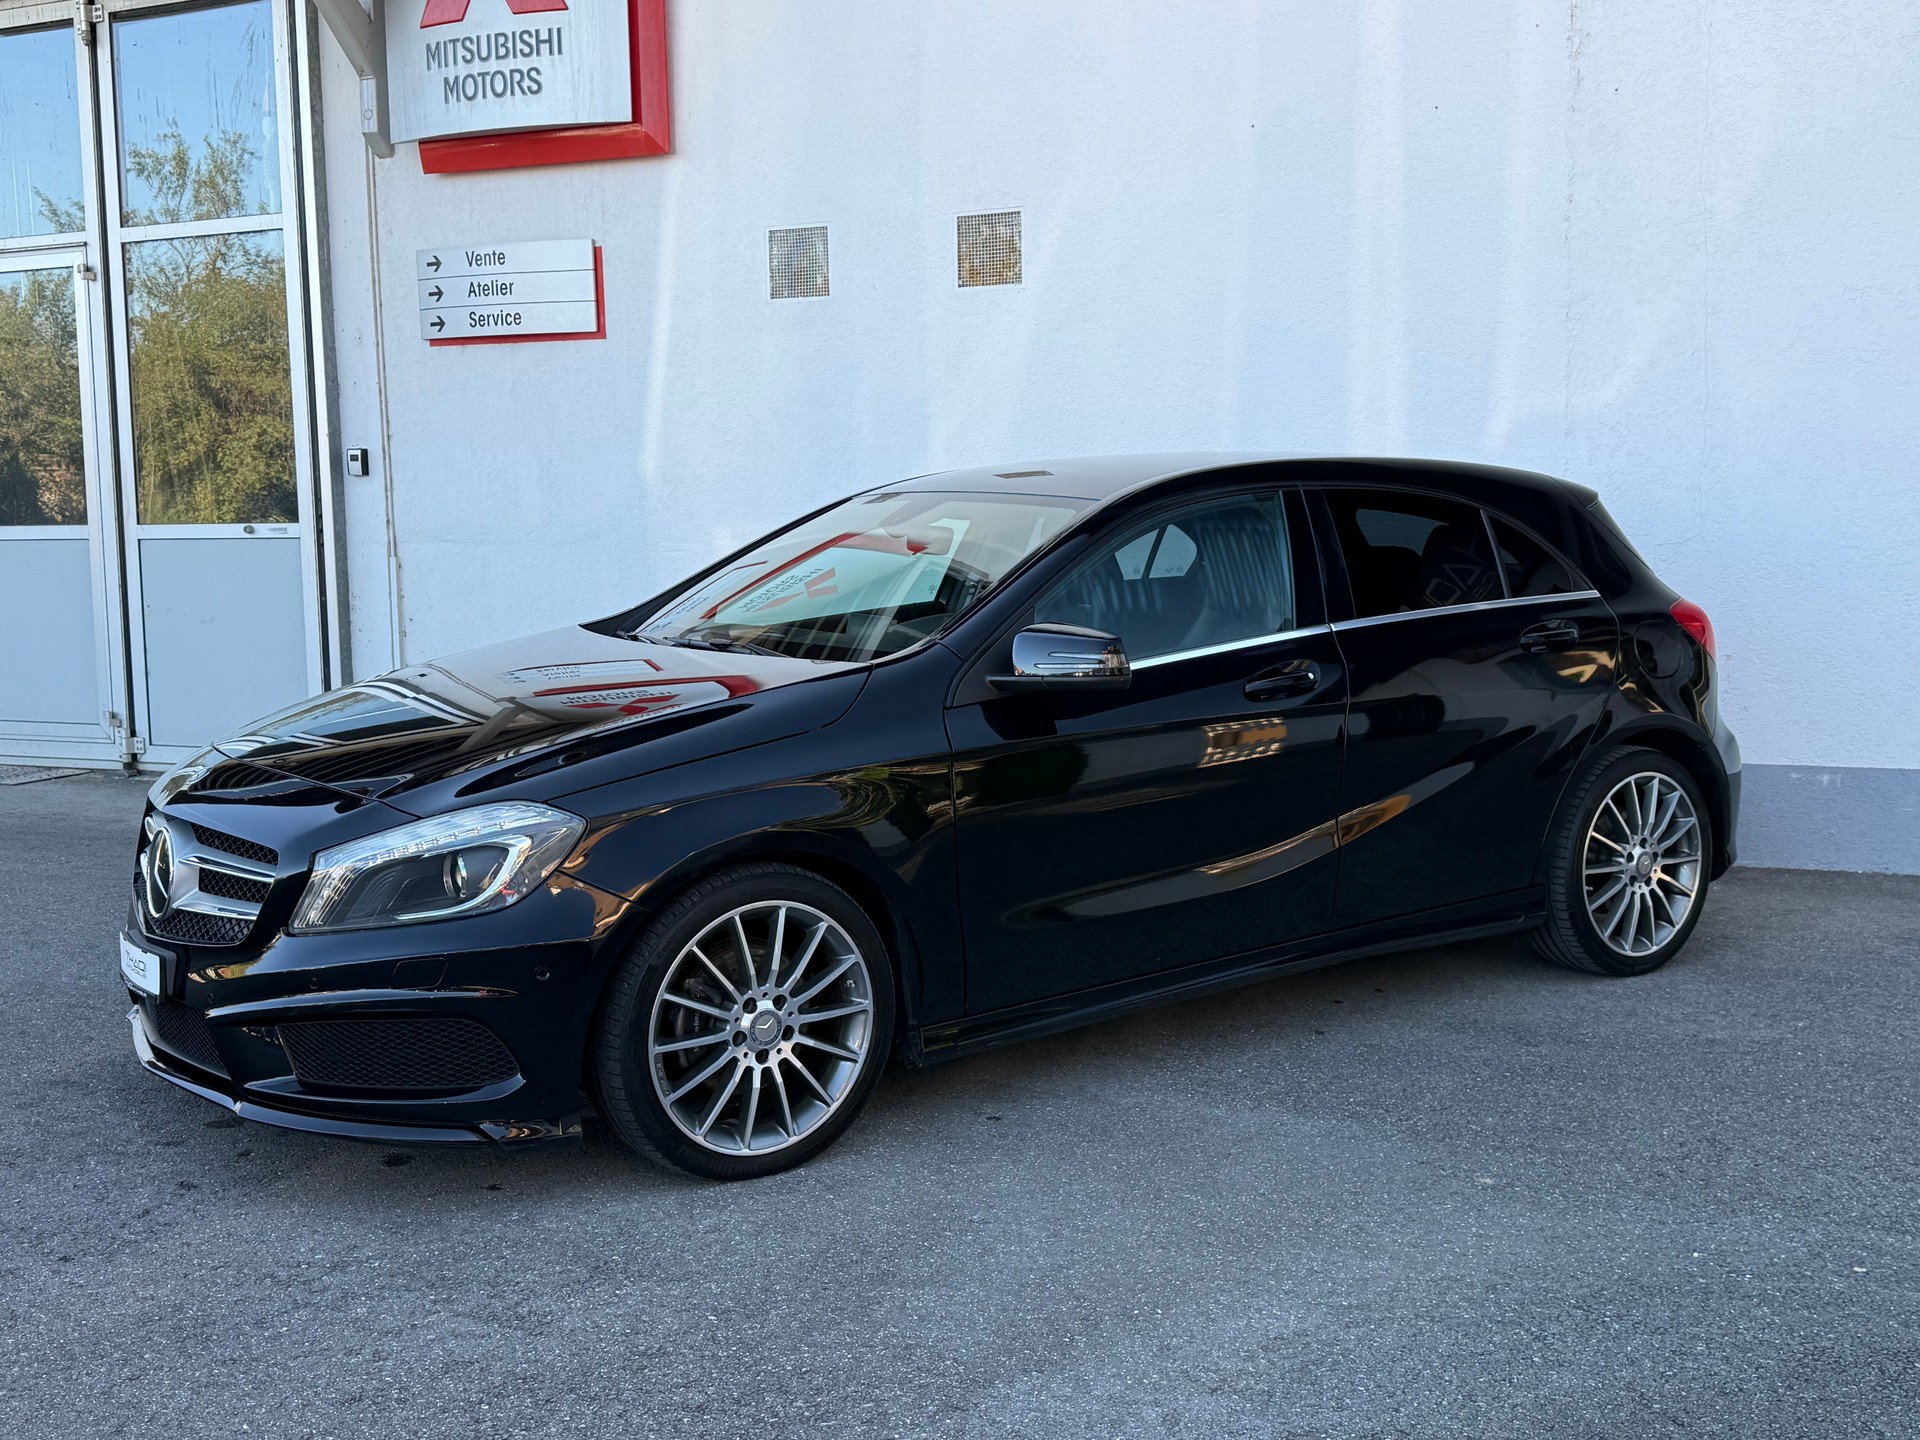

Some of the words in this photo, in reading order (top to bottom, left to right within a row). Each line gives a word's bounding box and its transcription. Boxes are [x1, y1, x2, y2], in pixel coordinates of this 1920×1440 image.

[425, 27, 563, 71] MITSUBISHI
[443, 67, 543, 104] MOTORS
[465, 250, 505, 267] Vente
[467, 279, 514, 298] Atelier
[469, 309, 522, 328] Service
